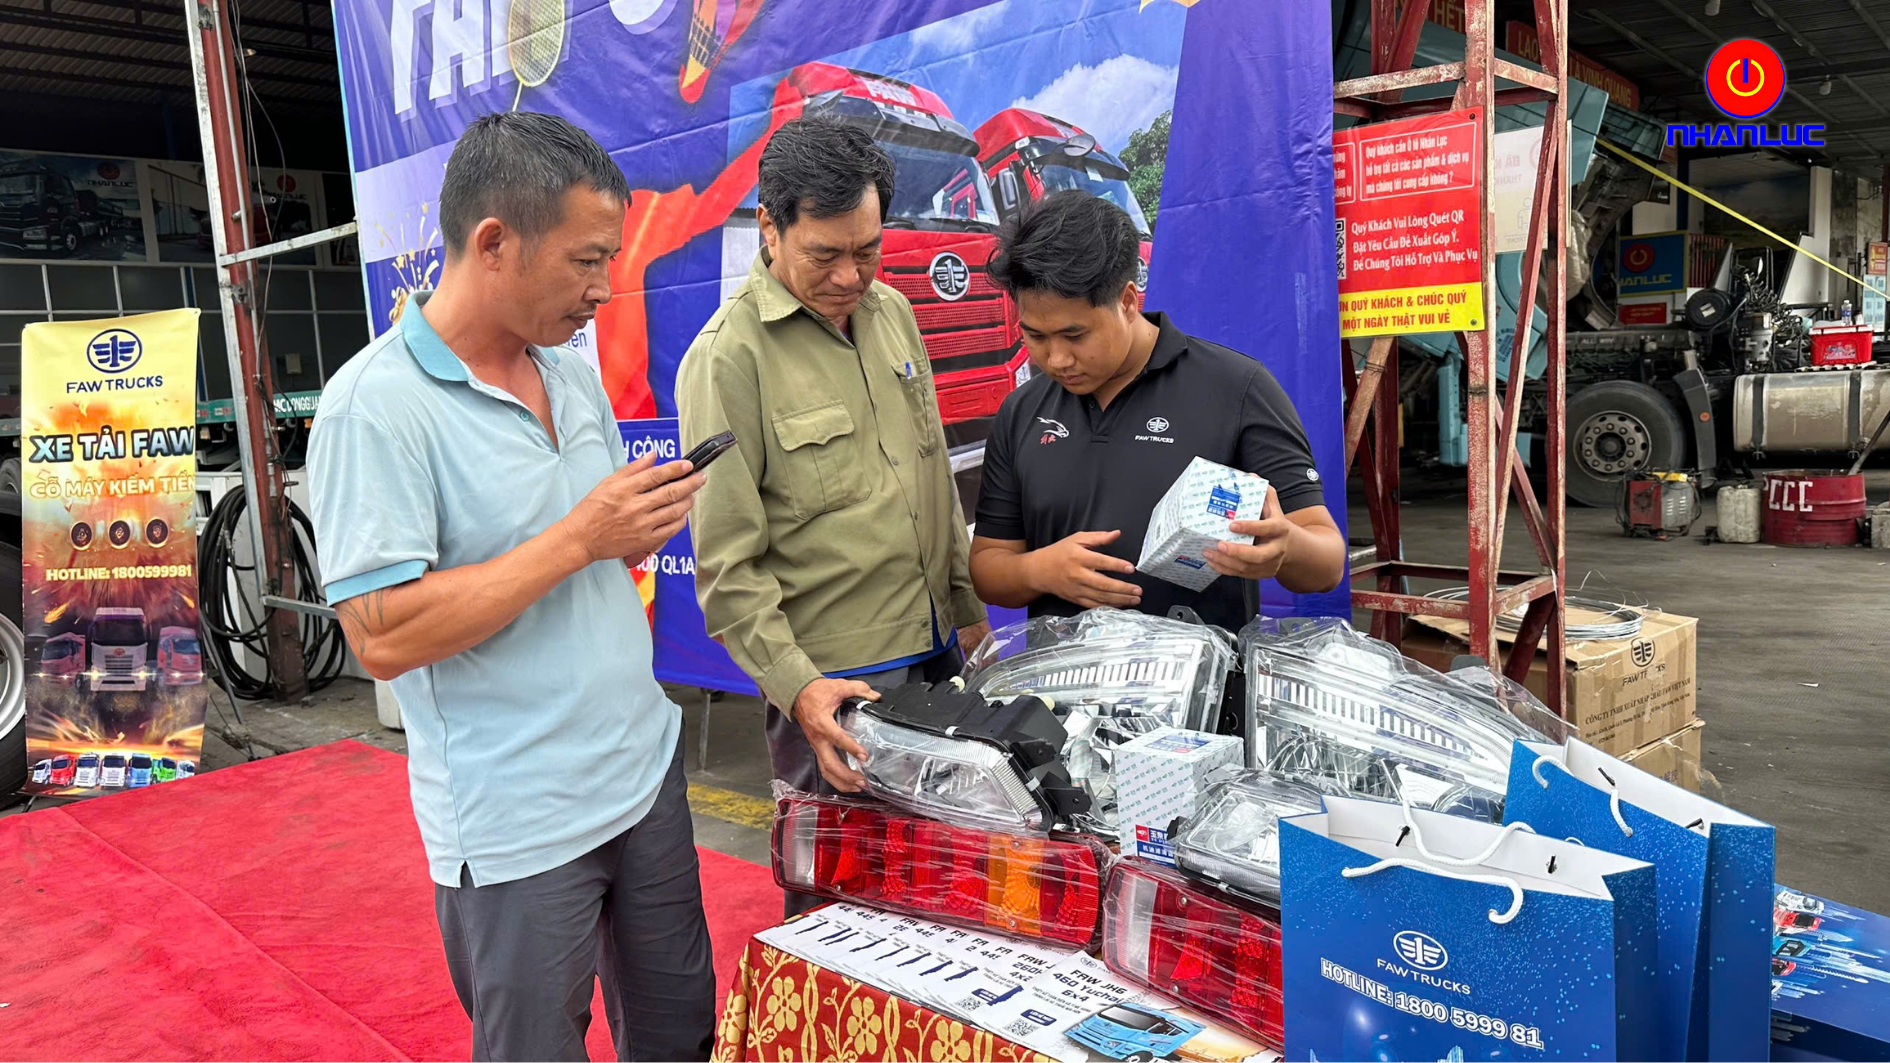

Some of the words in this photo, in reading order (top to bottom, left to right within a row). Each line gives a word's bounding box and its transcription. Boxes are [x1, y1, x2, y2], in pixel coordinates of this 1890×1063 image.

[1420, 137, 1435, 148] Nhân
[1437, 135, 1448, 149] Lực
[1441, 155, 1446, 165] &
[1449, 171, 1453, 183] ?
[1352, 220, 1367, 235] Quý
[1368, 219, 1392, 232] Khách
[1393, 216, 1407, 229] Vui
[1408, 214, 1427, 229] Lòng
[1429, 211, 1449, 226] Quét
[1451, 209, 1464, 224] QR
[1353, 241, 1366, 255] Đặt
[1367, 239, 1382, 252] Yêu
[1383, 236, 1398, 250] Cầu
[1400, 234, 1411, 248] Đề
[1412, 233, 1431, 247] Xuất
[1433, 232, 1450, 246] Góp
[1451, 228, 1459, 243] Ý.
[1365, 256, 1390, 271] Chúng
[1391, 255, 1404, 267] Tôi
[1405, 251, 1416, 266] Hỗ
[1418, 253, 1432, 268] Trợ
[1433, 250, 1443, 263] Và
[1445, 251, 1465, 264] Phục
[1466, 248, 1478, 263] Vụ
[1351, 297, 1368, 311] QUÝ
[1371, 295, 1403, 310] KHÁCH
[1406, 296, 1414, 307] &
[1417, 291, 1444, 306] CHÚC
[1447, 289, 1467, 305] QUÝ
[1343, 314, 1361, 332] MỘT
[1364, 312, 1389, 329] NGÀY
[1391, 312, 1416, 328] THẬT
[1418, 312, 1435, 325] VUI
[1438, 308, 1450, 324] VẺ
[66, 380, 103, 394] FAW
[105, 375, 163, 391] TRUCKS
[29, 434, 73, 463] XE
[78, 425, 126, 460] TẢI
[131, 426, 195, 457] FAW
[632, 435, 676, 459] CÔNG
[65, 477, 105, 498] MÁY
[109, 472, 155, 496] KIẾM
[46, 567, 110, 581] HOTLINE:
[112, 564, 192, 579] 1800599981
[661, 554, 696, 576] QL1A
[1622, 673, 1640, 687] FAW
[1018, 953, 1047, 966] FAW
[1052, 971, 1079, 988] 460
[1070, 969, 1102, 985] FAW
[1100, 983, 1128, 995] JH6
[1377, 958, 1408, 978] FAW
[1410, 970, 1471, 995] TRUCKS
[1061, 989, 1090, 1003] 6x4
[1320, 957, 1394, 1008] HOTLINE:
[1395, 991, 1449, 1023] 1800
[1450, 1006, 1508, 1040] 5999
[1511, 1023, 1544, 1050] 81
